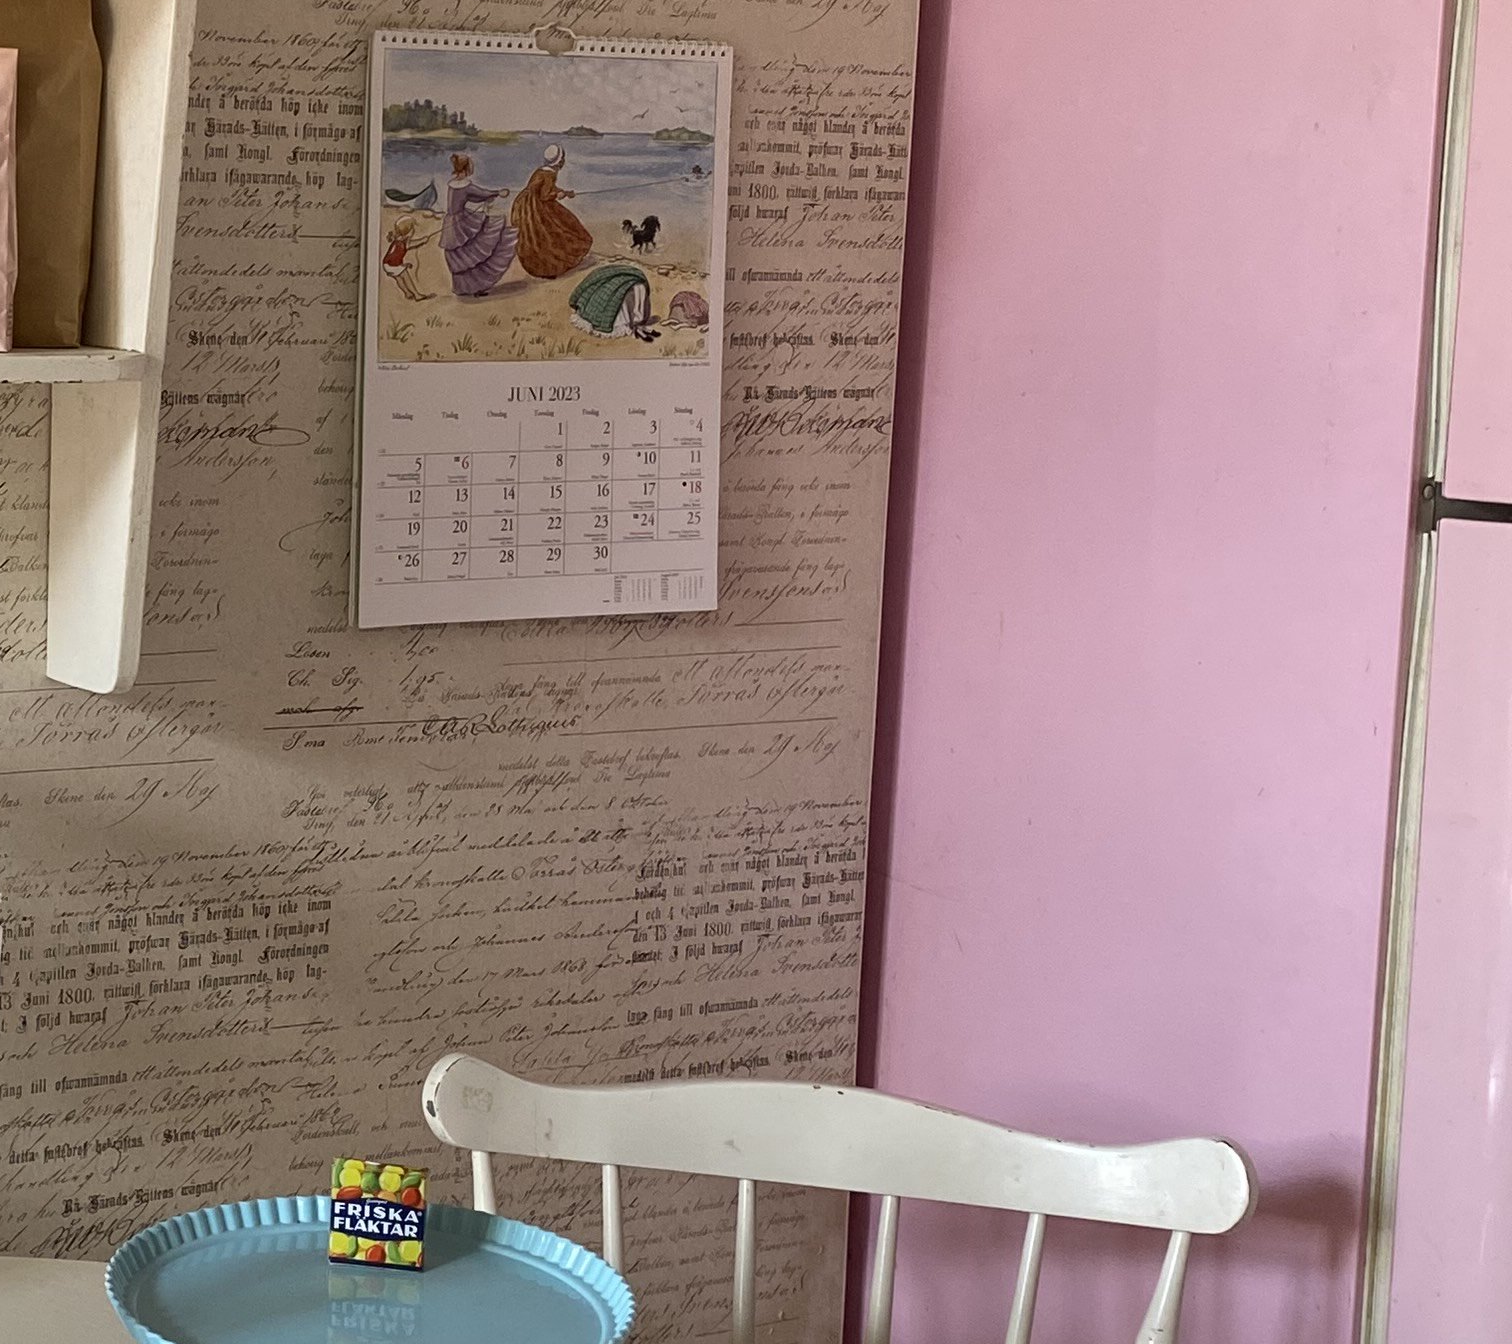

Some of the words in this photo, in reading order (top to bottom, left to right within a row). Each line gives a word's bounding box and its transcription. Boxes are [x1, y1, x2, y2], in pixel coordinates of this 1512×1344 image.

[508, 386, 544, 402] JUNI
[548, 386, 581, 402] 2023
[557, 422, 563, 435] 1
[603, 421, 611, 434] 2
[649, 420, 657, 434] 3
[696, 418, 703, 432] 4
[415, 457, 422, 472] 5
[461, 456, 469, 470] 6
[509, 455, 516, 469] 7
[556, 454, 563, 467] 8
[602, 452, 610, 466] 9
[643, 451, 657, 465] 10
[690, 450, 701, 463] 11
[408, 490, 421, 503] 12
[455, 488, 469, 502] 13
[503, 486, 515, 500] 14
[550, 485, 563, 499] 15
[597, 483, 609, 497] 16
[643, 482, 656, 495] 17
[689, 481, 702, 494] 18
[407, 522, 421, 536] 19
[452, 520, 468, 533] 20
[500, 518, 513, 532] 21
[547, 516, 562, 530] 22
[594, 515, 609, 528] 23
[641, 513, 655, 527] 24
[687, 511, 701, 525] 25
[404, 554, 420, 568] 26
[451, 552, 467, 566] 27
[499, 550, 514, 564] 28
[546, 548, 561, 561] 29
[593, 546, 609, 560] 30
[333, 1201, 420, 1224] FRISKA
[333, 1214, 419, 1238] FLÄKTAR
